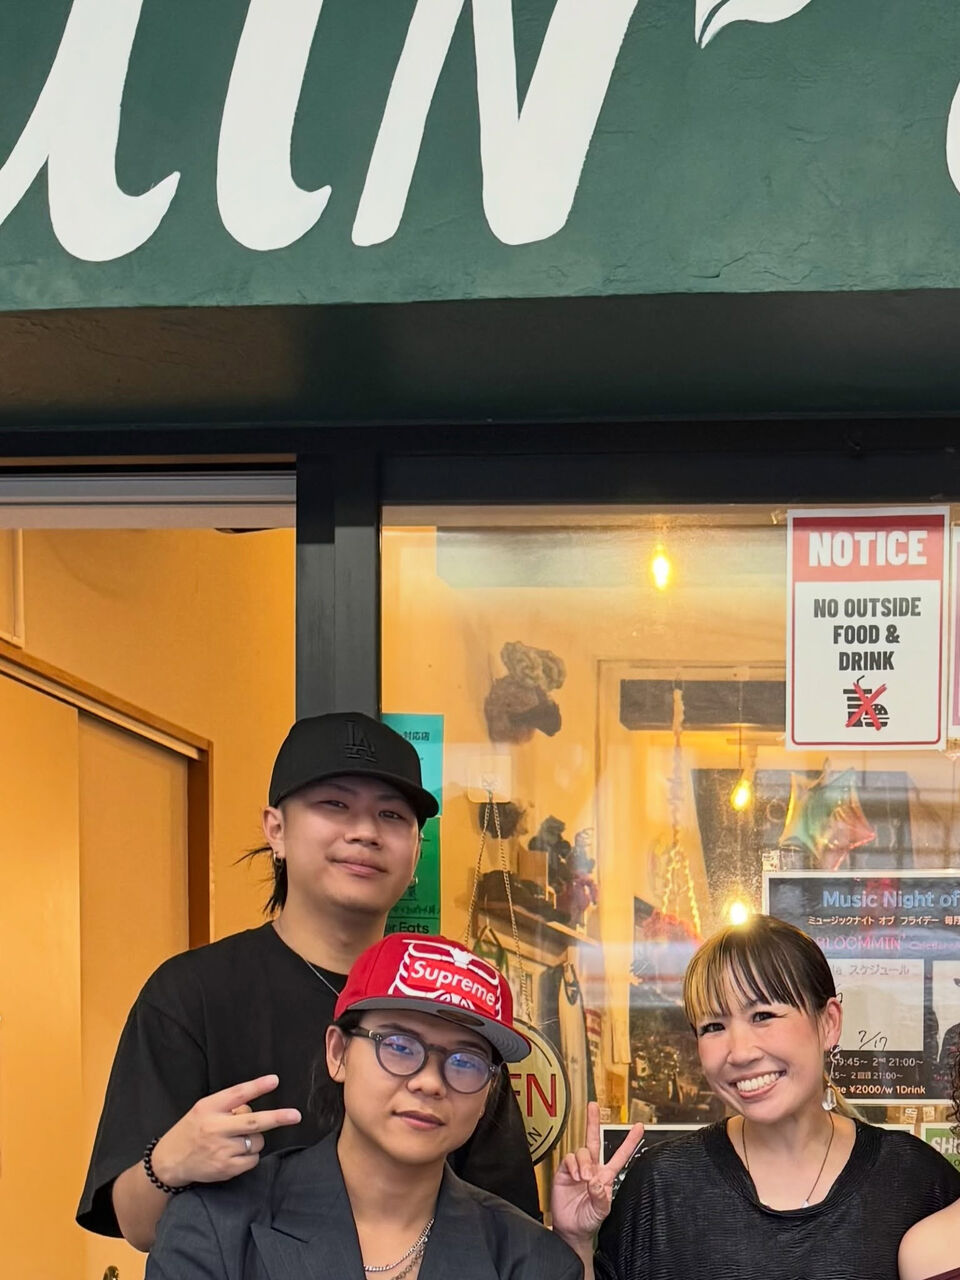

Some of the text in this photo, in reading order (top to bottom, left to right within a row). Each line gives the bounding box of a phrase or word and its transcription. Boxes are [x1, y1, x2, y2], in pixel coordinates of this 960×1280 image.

[808, 531, 928, 567] NOTICE
[813, 597, 921, 618] NO OUTSIDE
[833, 624, 900, 644] FOOD &
[838, 651, 895, 671] DRINK
[344, 720, 378, 763] LA
[822, 890, 877, 908] Music
[883, 889, 935, 909] Night
[940, 890, 960, 907] of
[399, 923, 430, 934] Eats
[808, 916, 875, 926] ミュージックナイト
[879, 916, 895, 926] オブ
[901, 916, 939, 926] フライデー
[410, 961, 496, 1006] Supreme
[896, 1085, 926, 1094] 1Drink
